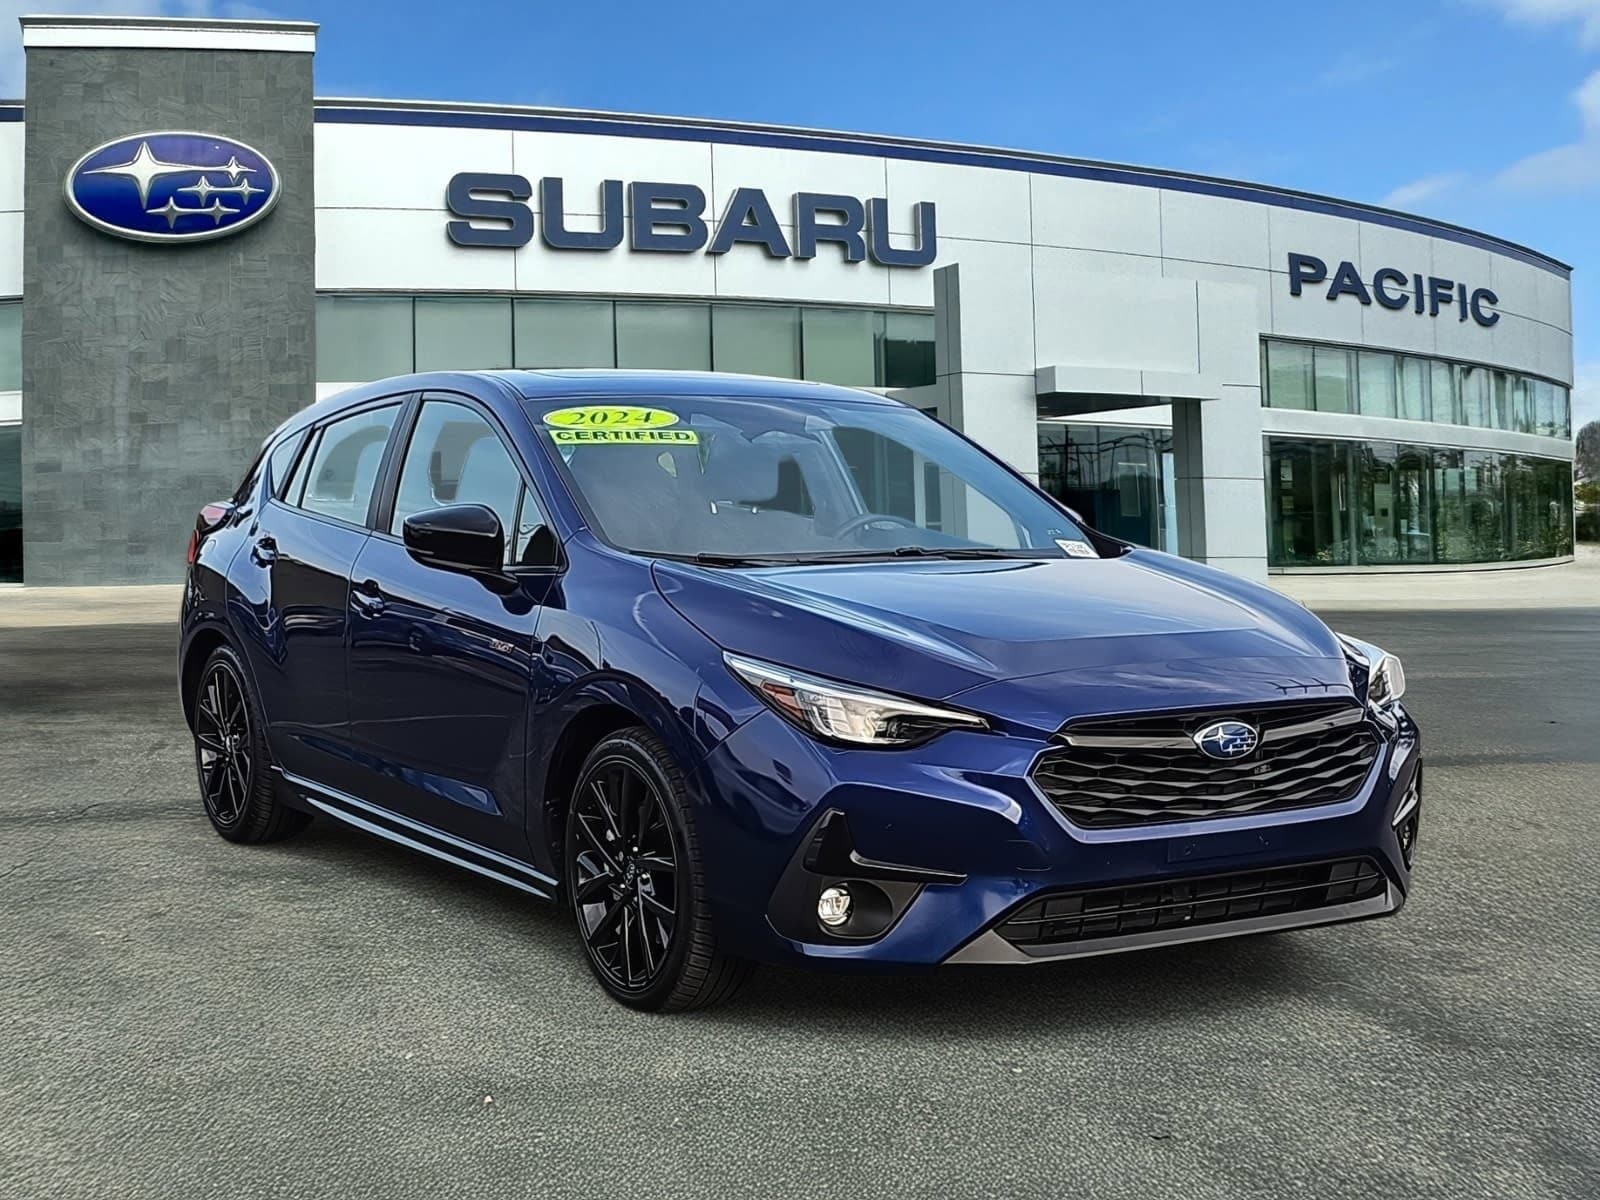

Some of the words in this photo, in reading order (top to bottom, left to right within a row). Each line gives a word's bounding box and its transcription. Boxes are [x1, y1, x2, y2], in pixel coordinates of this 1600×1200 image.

[446, 171, 937, 268] SUBARU
[1287, 251, 1500, 328] PACIFIC
[556, 430, 693, 441] CERTIFIED
[569, 411, 654, 425] 2024
